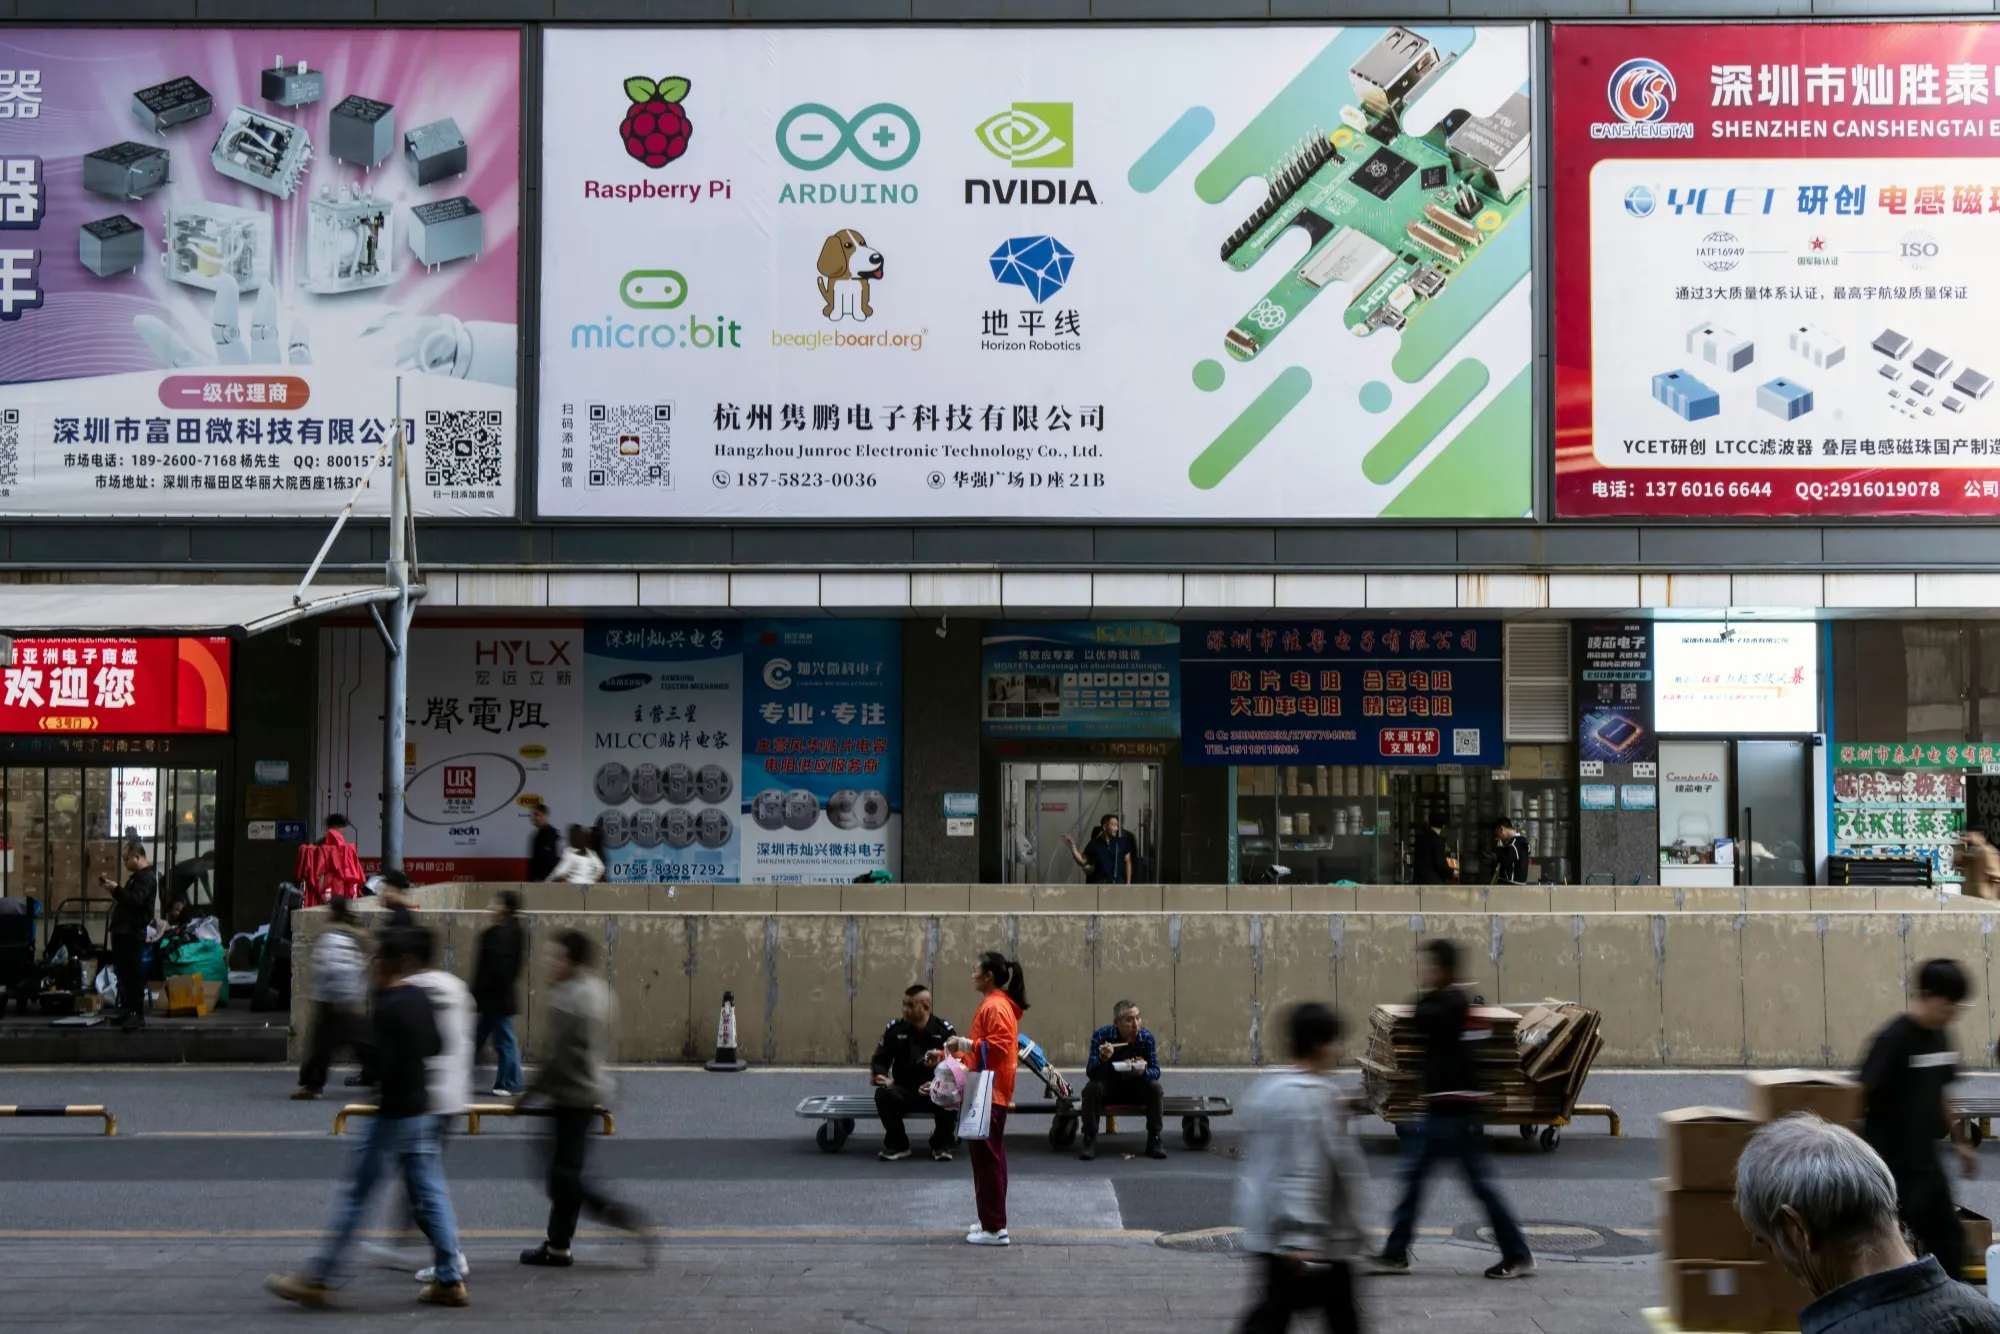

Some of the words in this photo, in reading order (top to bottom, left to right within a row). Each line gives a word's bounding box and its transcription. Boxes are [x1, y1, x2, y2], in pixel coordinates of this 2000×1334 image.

[1711, 63, 2000, 106] 深圳市灿胜泰
[1591, 123, 1693, 139] CANSHENGTAI
[1712, 120, 1827, 138] SHENZHEN
[1832, 120, 1984, 137] CANSHENGTAI
[584, 180, 702, 203] Raspberry
[708, 179, 732, 199] Pi
[778, 184, 919, 204] ARDUINO
[1797, 184, 1866, 216] 研创
[1696, 247, 1745, 257] IATF16949
[1900, 243, 1939, 257] ISO
[1359, 266, 1408, 312] HDMI
[571, 314, 742, 348] micro:bit
[981, 309, 1081, 337] 地平线
[771, 329, 923, 350] beagleboard.org
[981, 340, 1026, 351] Horizon
[1029, 340, 1081, 351] Robotics
[181, 382, 288, 403] 一级代理商
[713, 402, 1104, 432] 杭州隽鹏电子科技有限公司
[561, 402, 574, 488] 扫码添加微信
[714, 443, 794, 459] Hangzhou
[796, 444, 851, 458] Junroc
[856, 443, 938, 457] Electronic
[941, 443, 1033, 460] Technology
[1037, 444, 1068, 458] Co.,
[1072, 444, 1103, 458] Ltd.
[1623, 438, 1706, 455] YCET研创
[1715, 438, 1813, 455] LTCC滤波器
[736, 472, 877, 488] 187-5823-0036
[1795, 481, 1940, 499] QQ:2916019078
[1963, 480, 1999, 498] 公司
[432, 490, 495, 499] 扫一扫添加微信
[605, 627, 725, 650] 深圳灿兴电子
[475, 640, 572, 666] HYLX
[475, 670, 572, 686] 宏远立新
[796, 661, 885, 676] 灿兴微科电子
[4, 666, 136, 709] 欢迎您
[1230, 670, 1342, 692] 贴片电阻
[1362, 670, 1453, 692] 合金电阻
[378, 696, 550, 734] 聲電阻
[635, 704, 697, 723] 主营三星
[1230, 696, 1342, 717] 大功率电阻
[1362, 696, 1453, 717] 精密电阻
[756, 737, 888, 754] 主营风华贴片电容
[1384, 731, 1436, 742] 欢迎订货
[1840, 746, 2000, 764] 深圳市泰丰电子有限
[764, 757, 880, 773] 电阻供应服务商
[757, 842, 886, 857] 深圳市灿兴微科电子
[613, 863, 725, 876] 0755-83987292
